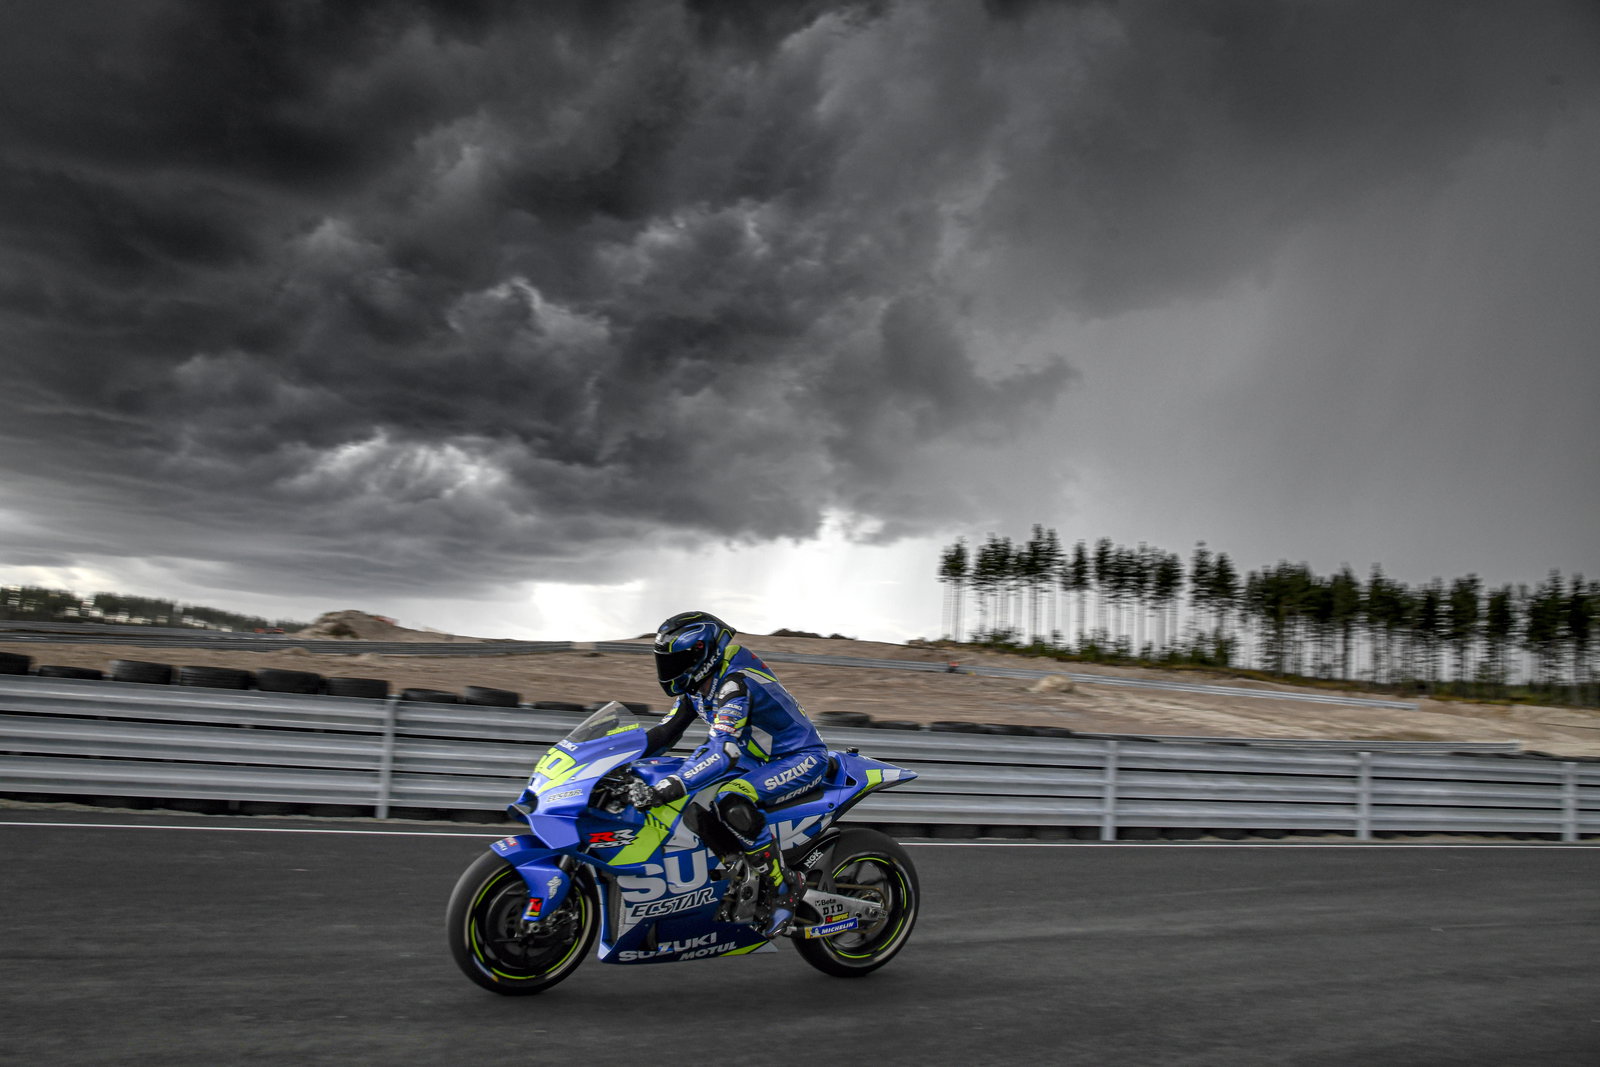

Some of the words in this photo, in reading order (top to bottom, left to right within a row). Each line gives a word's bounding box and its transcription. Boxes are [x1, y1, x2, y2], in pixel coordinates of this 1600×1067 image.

[683, 753, 721, 779] SUZUKI
[764, 755, 818, 791] SUZUKI
[775, 775, 823, 804] BERING
[804, 849, 822, 867] NGK
[631, 887, 718, 918] ECSTAR
[821, 921, 855, 935] MICHELIN
[618, 932, 718, 962] SUZUKI
[679, 942, 737, 961] MOTUL
